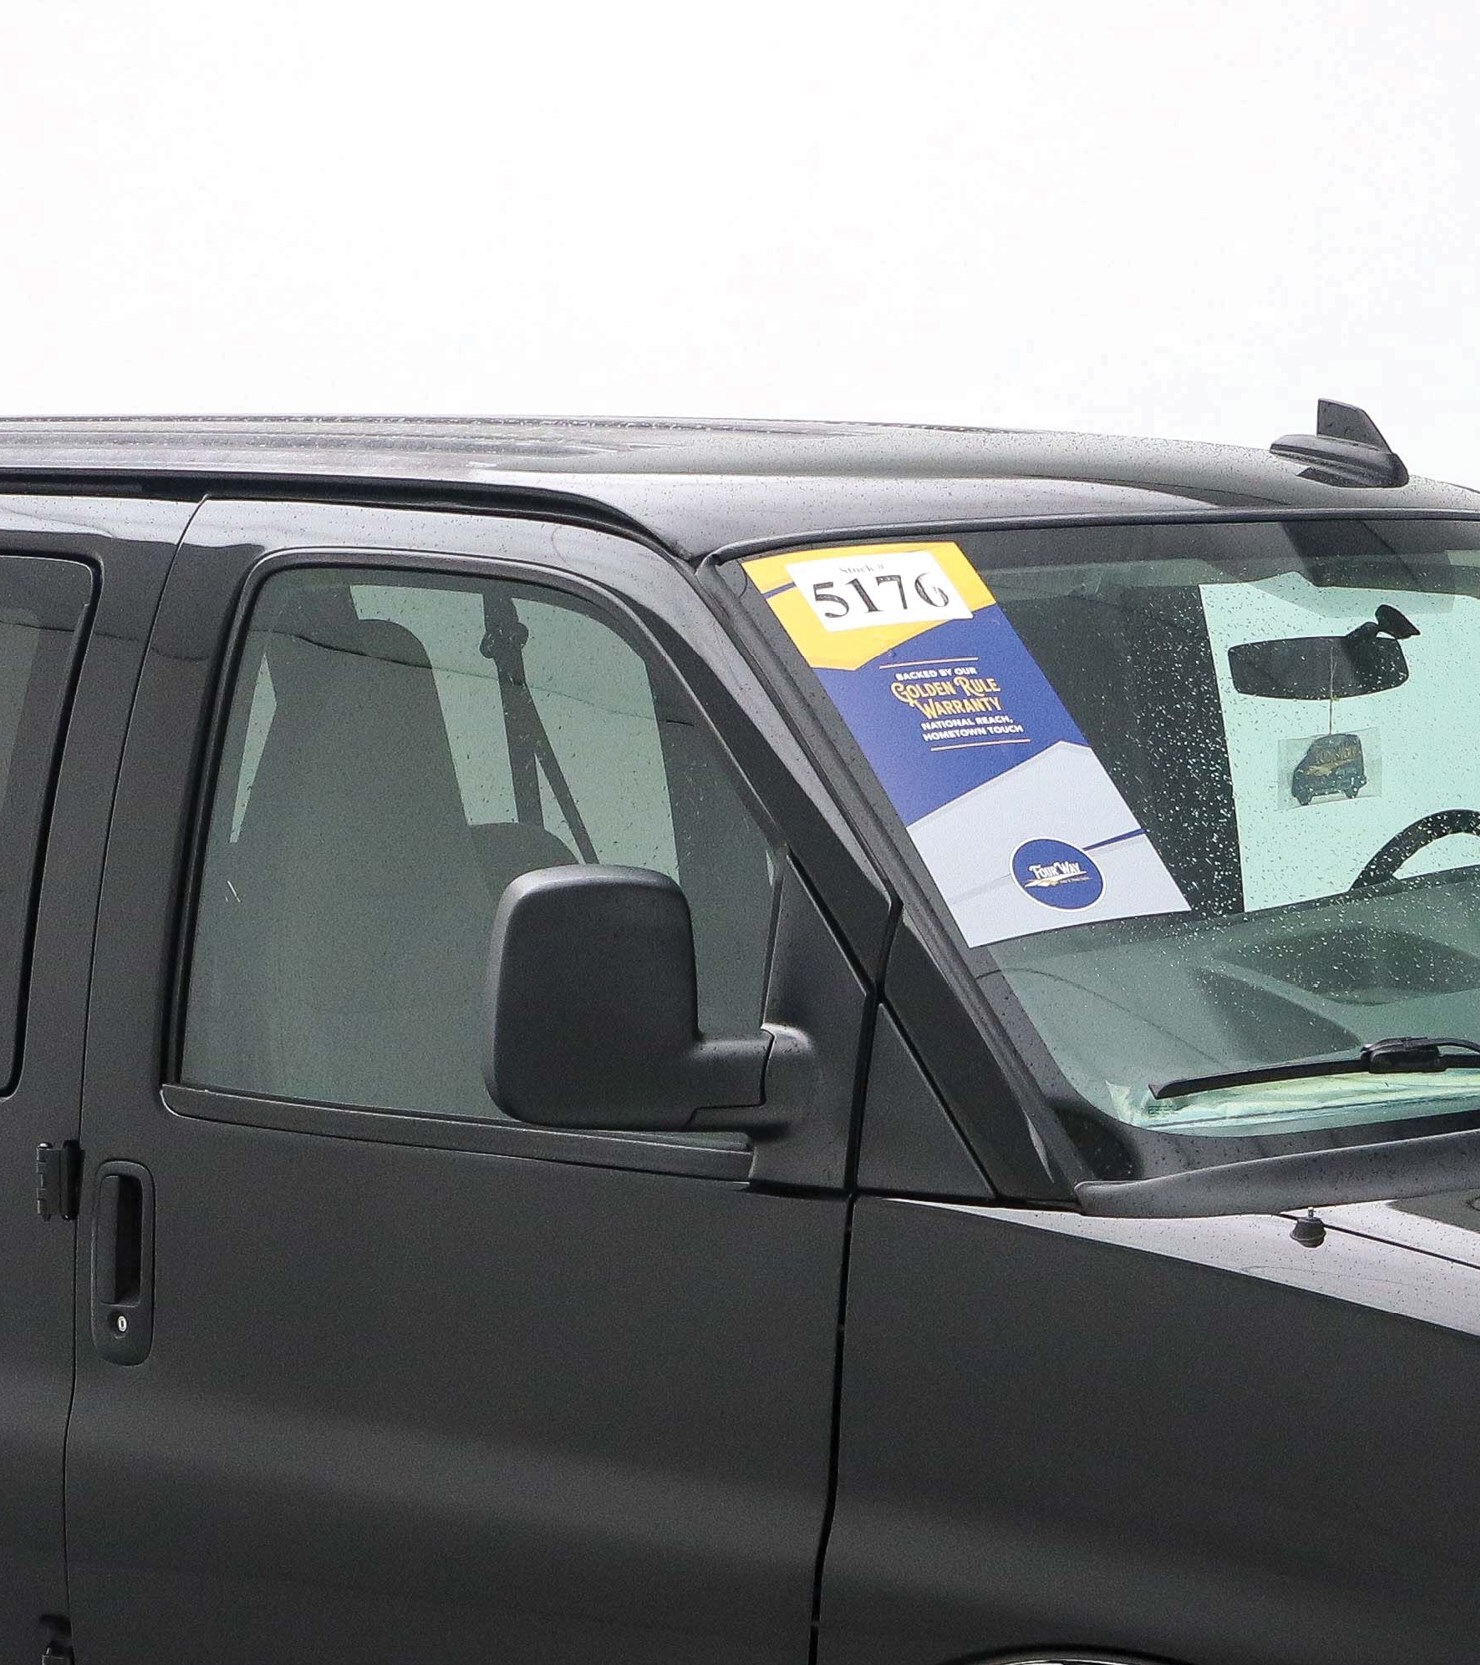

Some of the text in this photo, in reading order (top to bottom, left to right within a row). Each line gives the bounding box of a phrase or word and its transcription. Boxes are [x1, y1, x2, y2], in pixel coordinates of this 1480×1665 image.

[813, 572, 950, 618] 5176
[895, 667, 978, 681] BACKED BY OUR
[890, 676, 1001, 703] GOLDEN RULE
[908, 696, 1002, 720] WARRANTY
[921, 715, 1014, 731] NATIONAL REACH,
[922, 724, 1024, 742] HOMETOWN TOUCH
[1028, 861, 1081, 879] FOUR WAY
